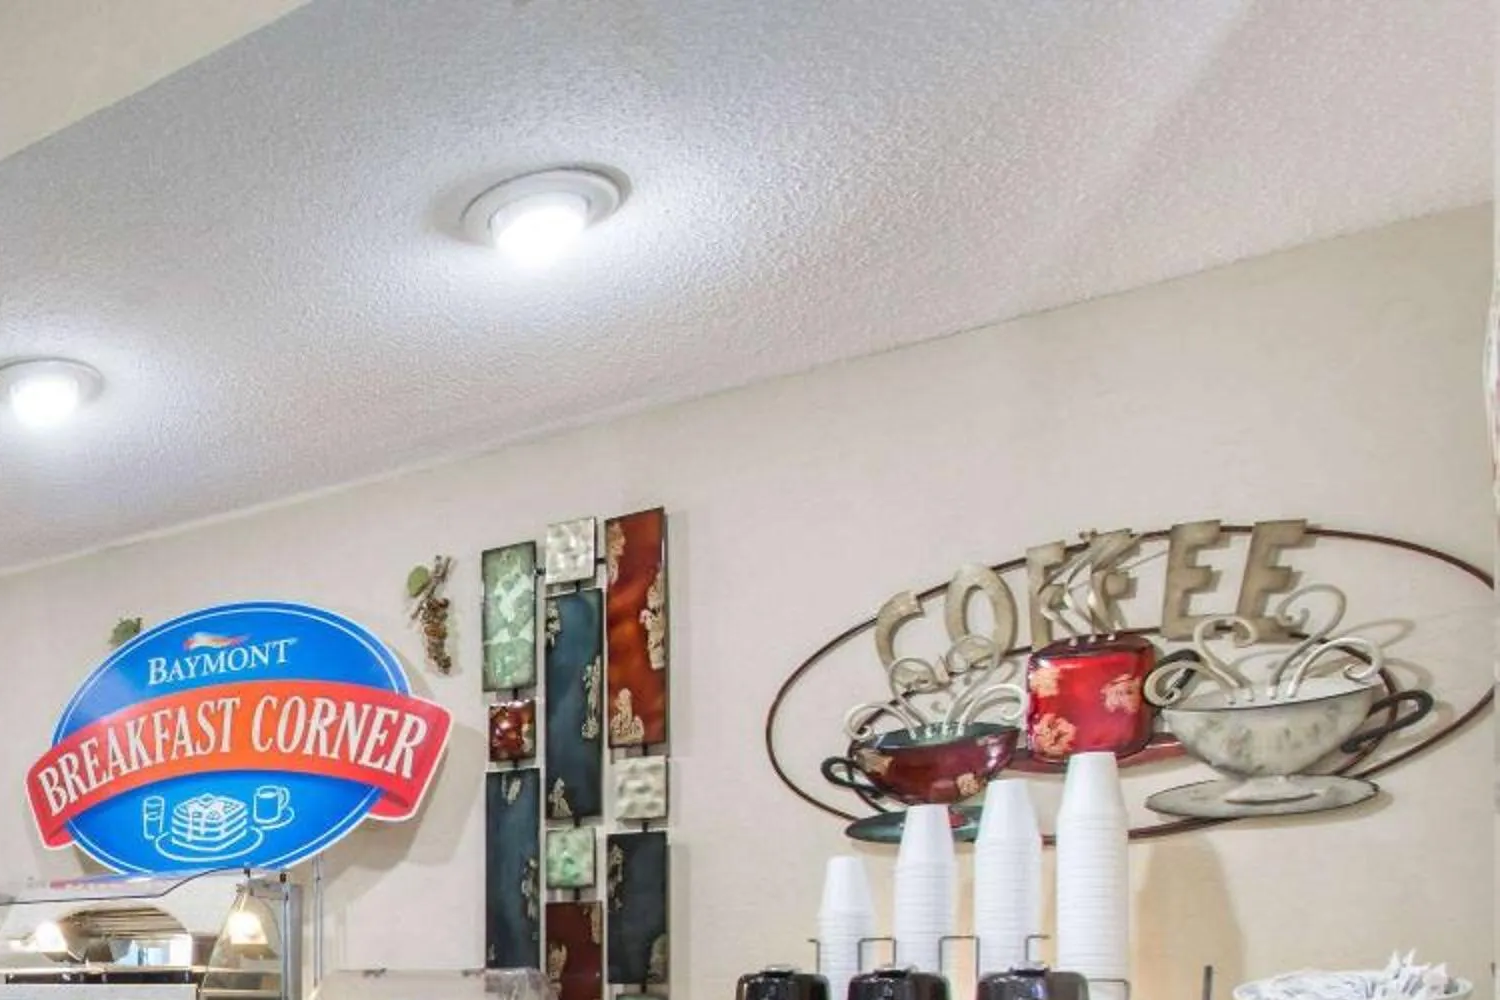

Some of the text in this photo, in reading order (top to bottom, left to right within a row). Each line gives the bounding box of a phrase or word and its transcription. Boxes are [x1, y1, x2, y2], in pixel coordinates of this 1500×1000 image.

[148, 640, 294, 686] BAYMONT
[875, 519, 1307, 694] COFFEE
[37, 695, 429, 818] BREAKFAST CORNER
